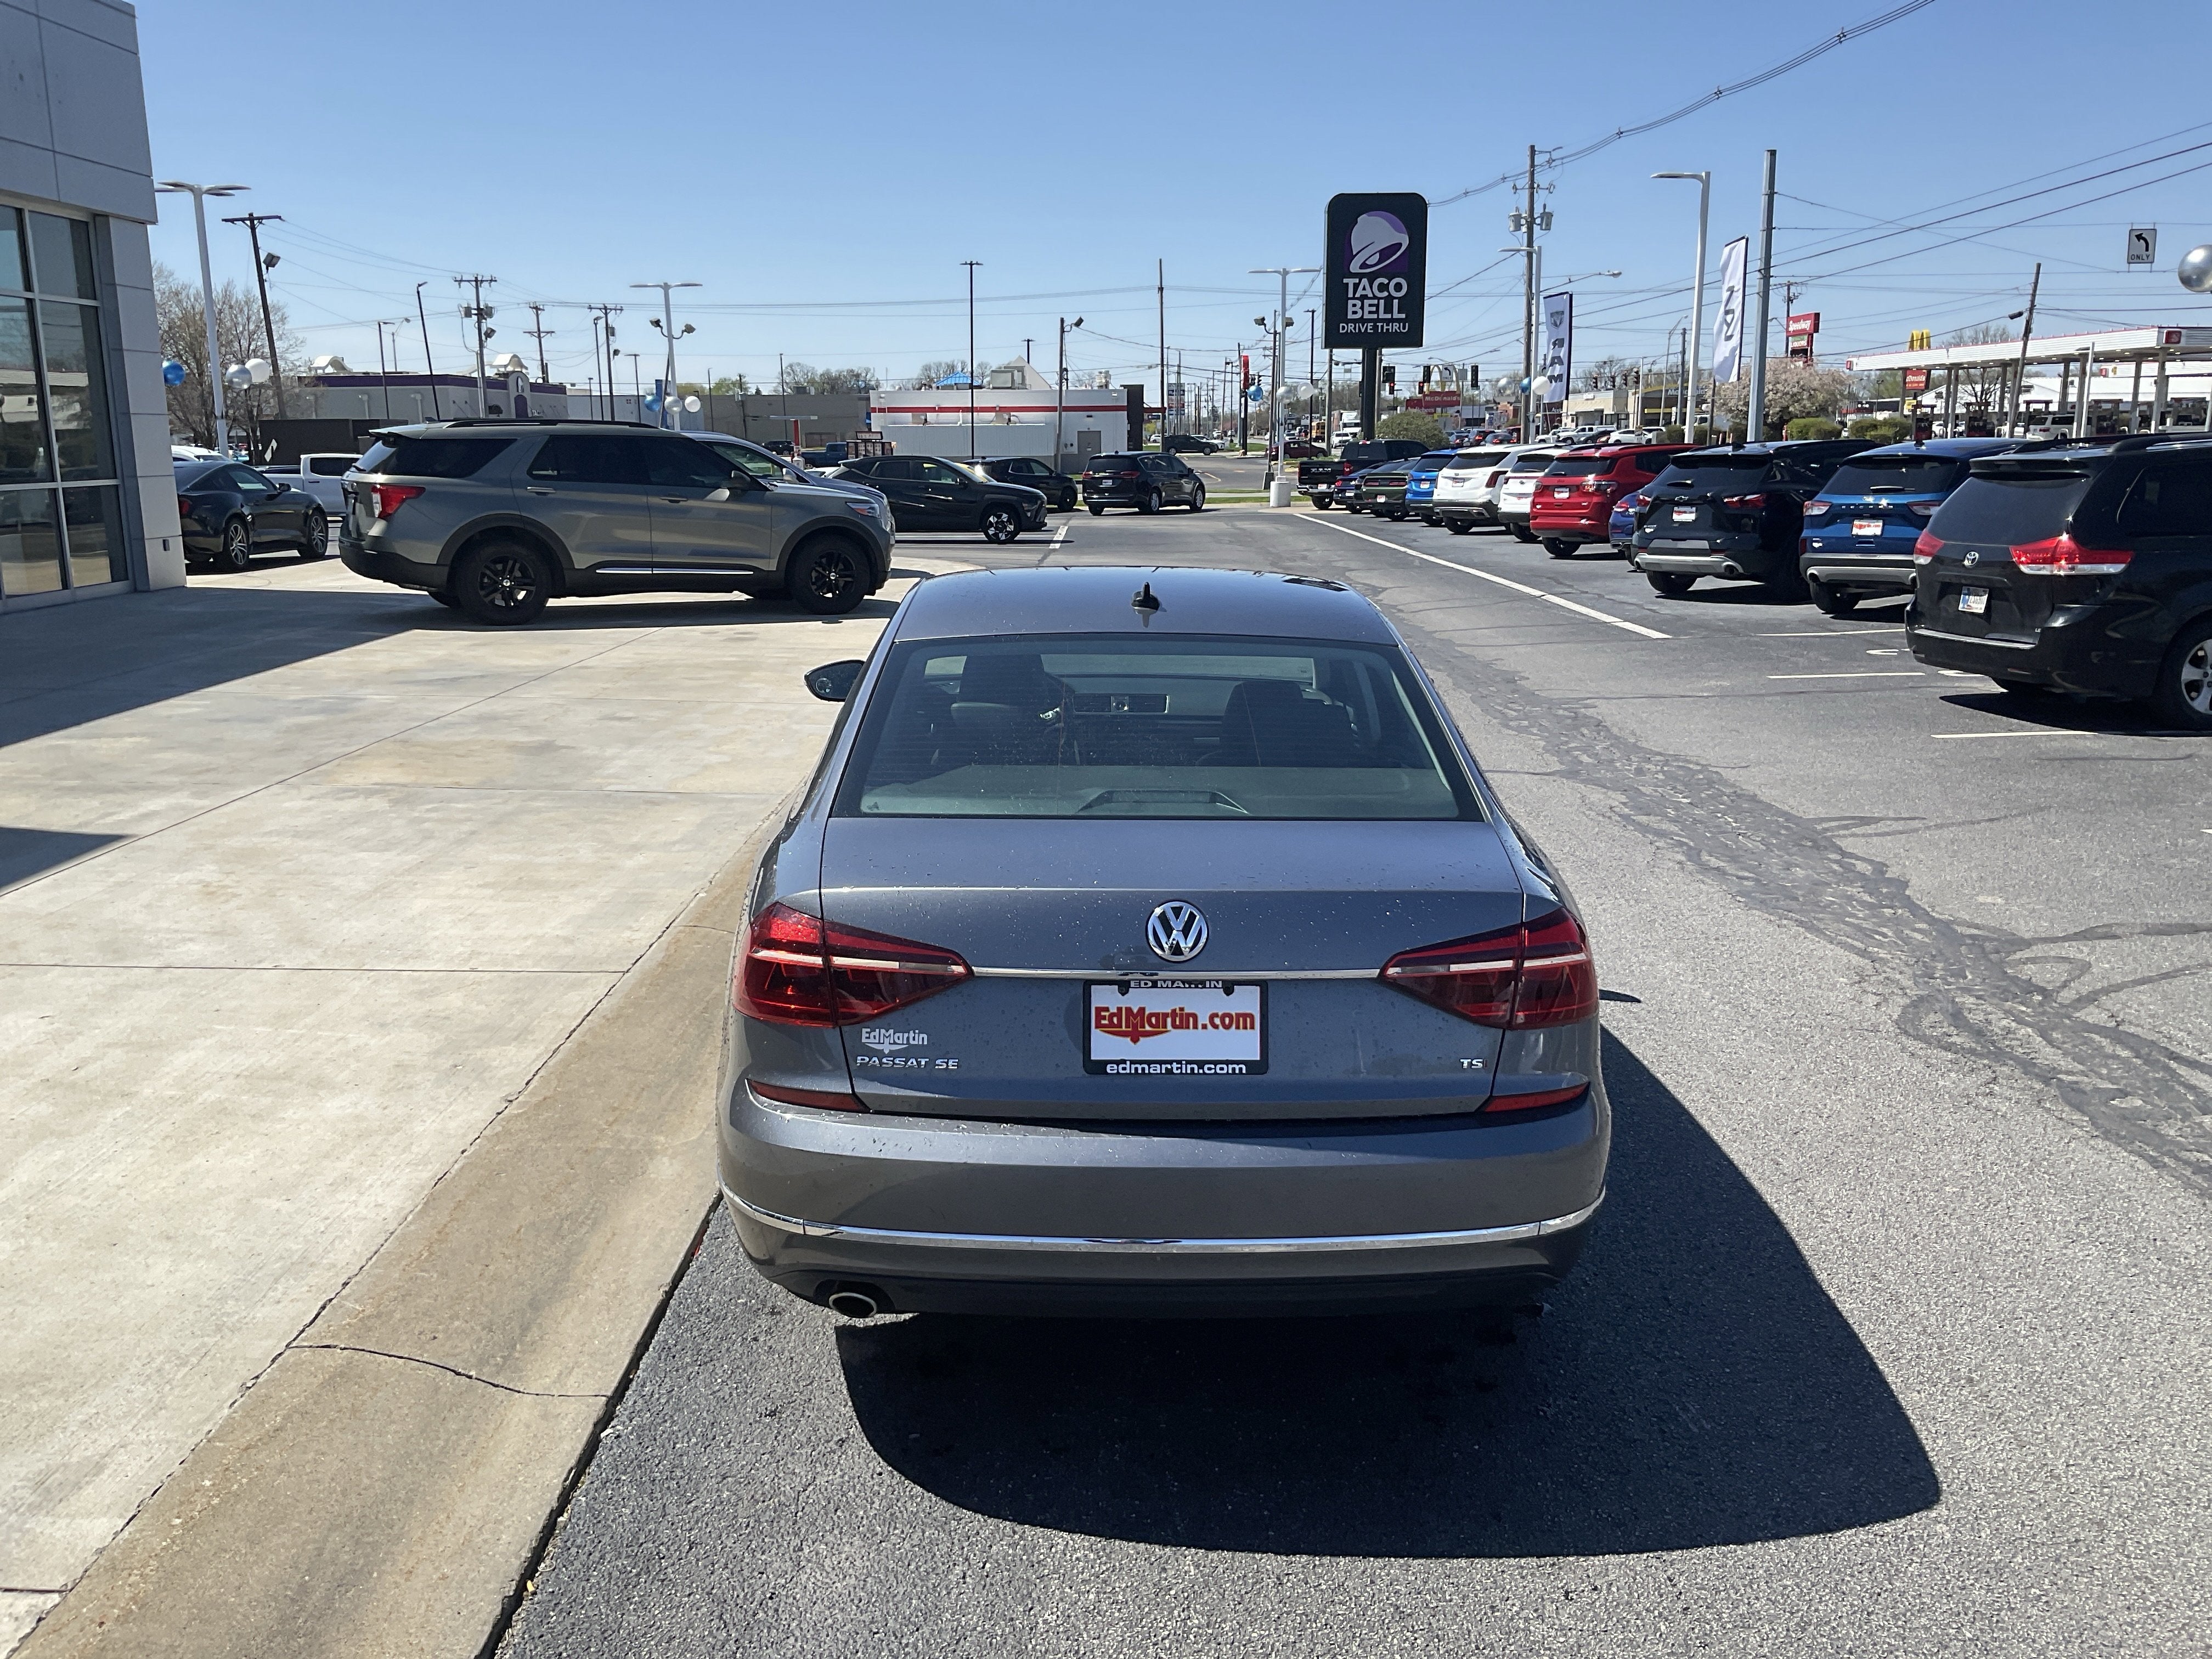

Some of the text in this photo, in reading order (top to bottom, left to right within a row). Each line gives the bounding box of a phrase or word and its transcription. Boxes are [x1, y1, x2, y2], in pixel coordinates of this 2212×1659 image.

[1342, 278, 1408, 298] TACO
[1347, 299, 1406, 319] BELL
[1339, 323, 1408, 333] DRIVE THRU
[1788, 319, 1812, 333] Speedway
[1094, 1006, 1255, 1030] EdMartin.com
[861, 1028, 928, 1045] EdMartin
[856, 1056, 959, 1069] PASSAT SE
[1106, 1060, 1246, 1074] edmartin.com
